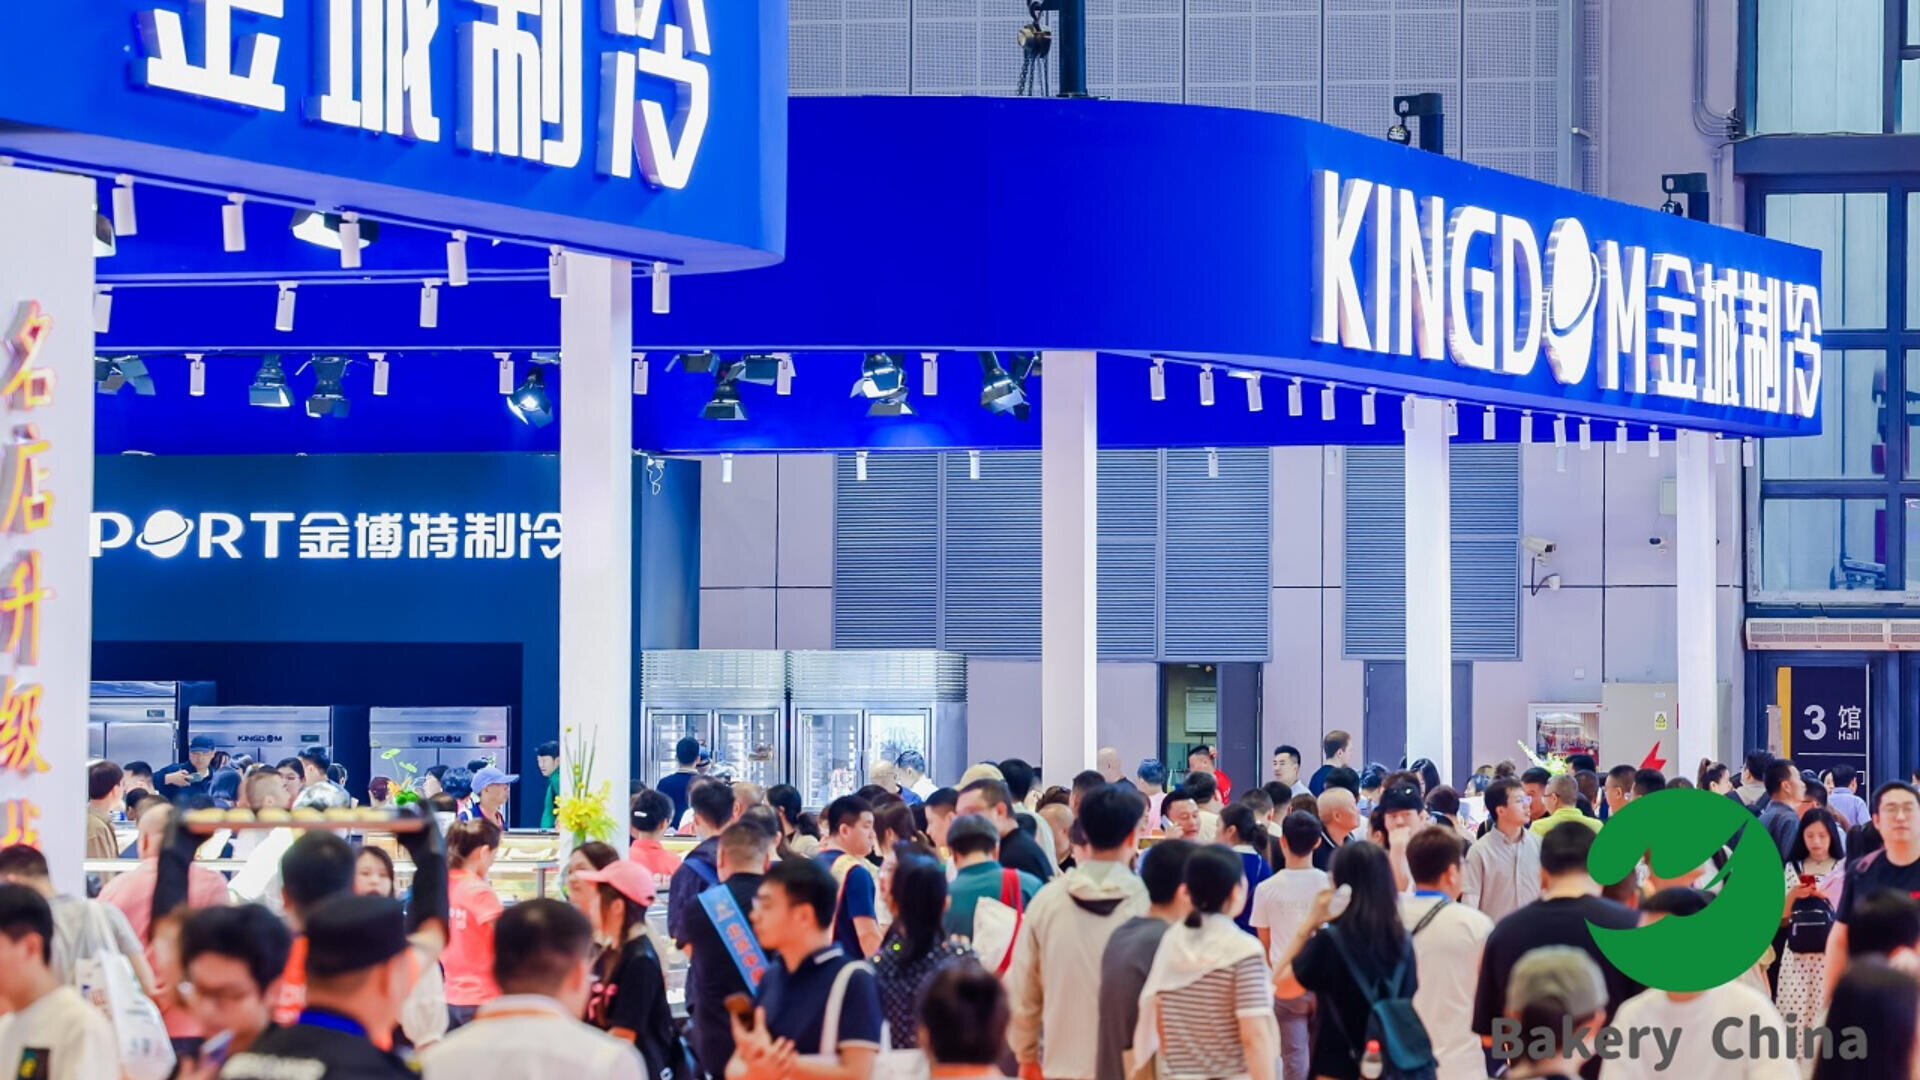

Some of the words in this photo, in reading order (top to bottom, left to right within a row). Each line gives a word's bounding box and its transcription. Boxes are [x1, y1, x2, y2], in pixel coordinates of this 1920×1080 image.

[1313, 170, 1646, 395] KINGDOM
[1650, 253, 1822, 418] 金城制冷
[299, 512, 561, 559] 金博特制冷
[1803, 704, 1827, 740] 3
[1838, 705, 1862, 729] 馆
[1838, 731, 1860, 740] Hall
